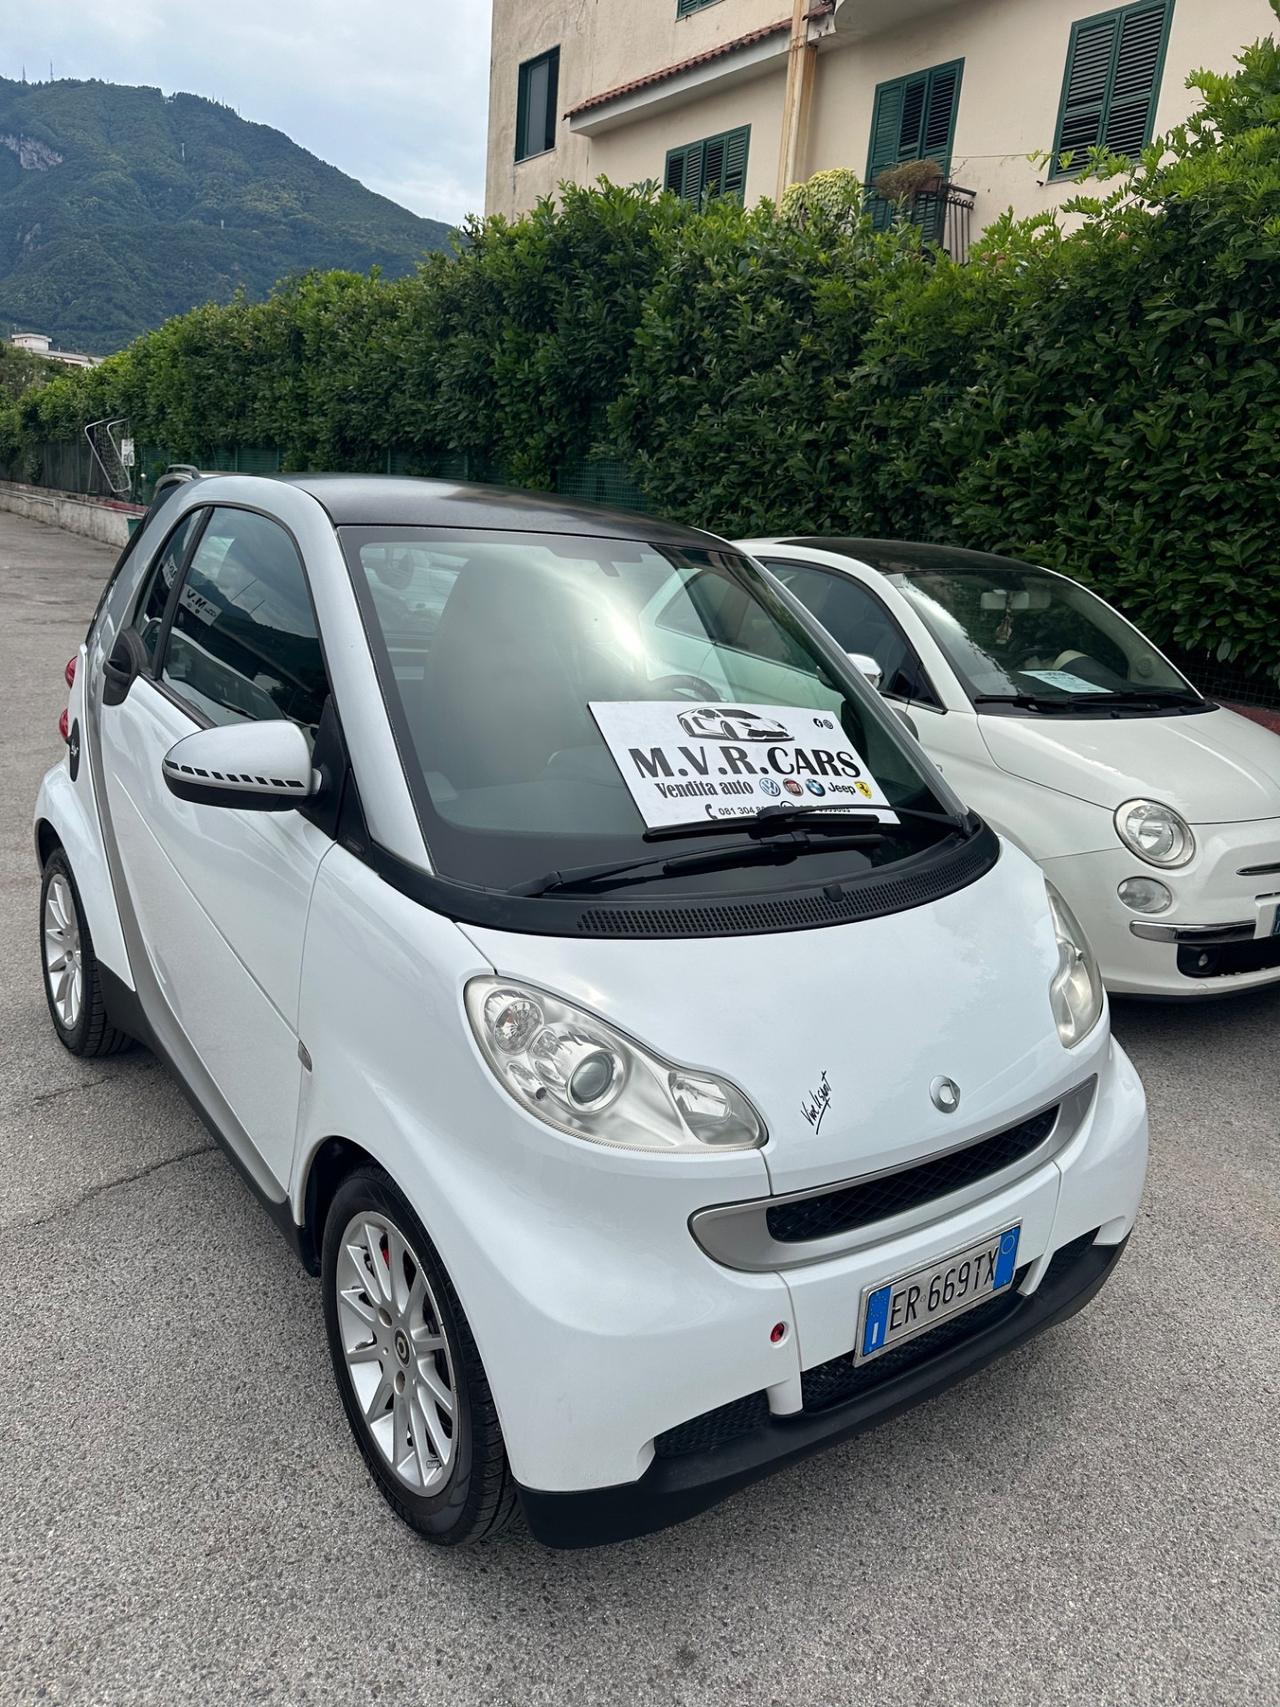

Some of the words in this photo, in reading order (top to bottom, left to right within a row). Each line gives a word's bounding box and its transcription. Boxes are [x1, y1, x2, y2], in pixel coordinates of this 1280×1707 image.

[654, 780, 718, 799] Vendita
[719, 779, 754, 795] auto
[828, 782, 856, 795] Jeep
[718, 807, 736, 816] 081
[737, 806, 755, 815] 304
[889, 1285, 920, 1331] ER
[927, 1246, 999, 1312] 669TX
